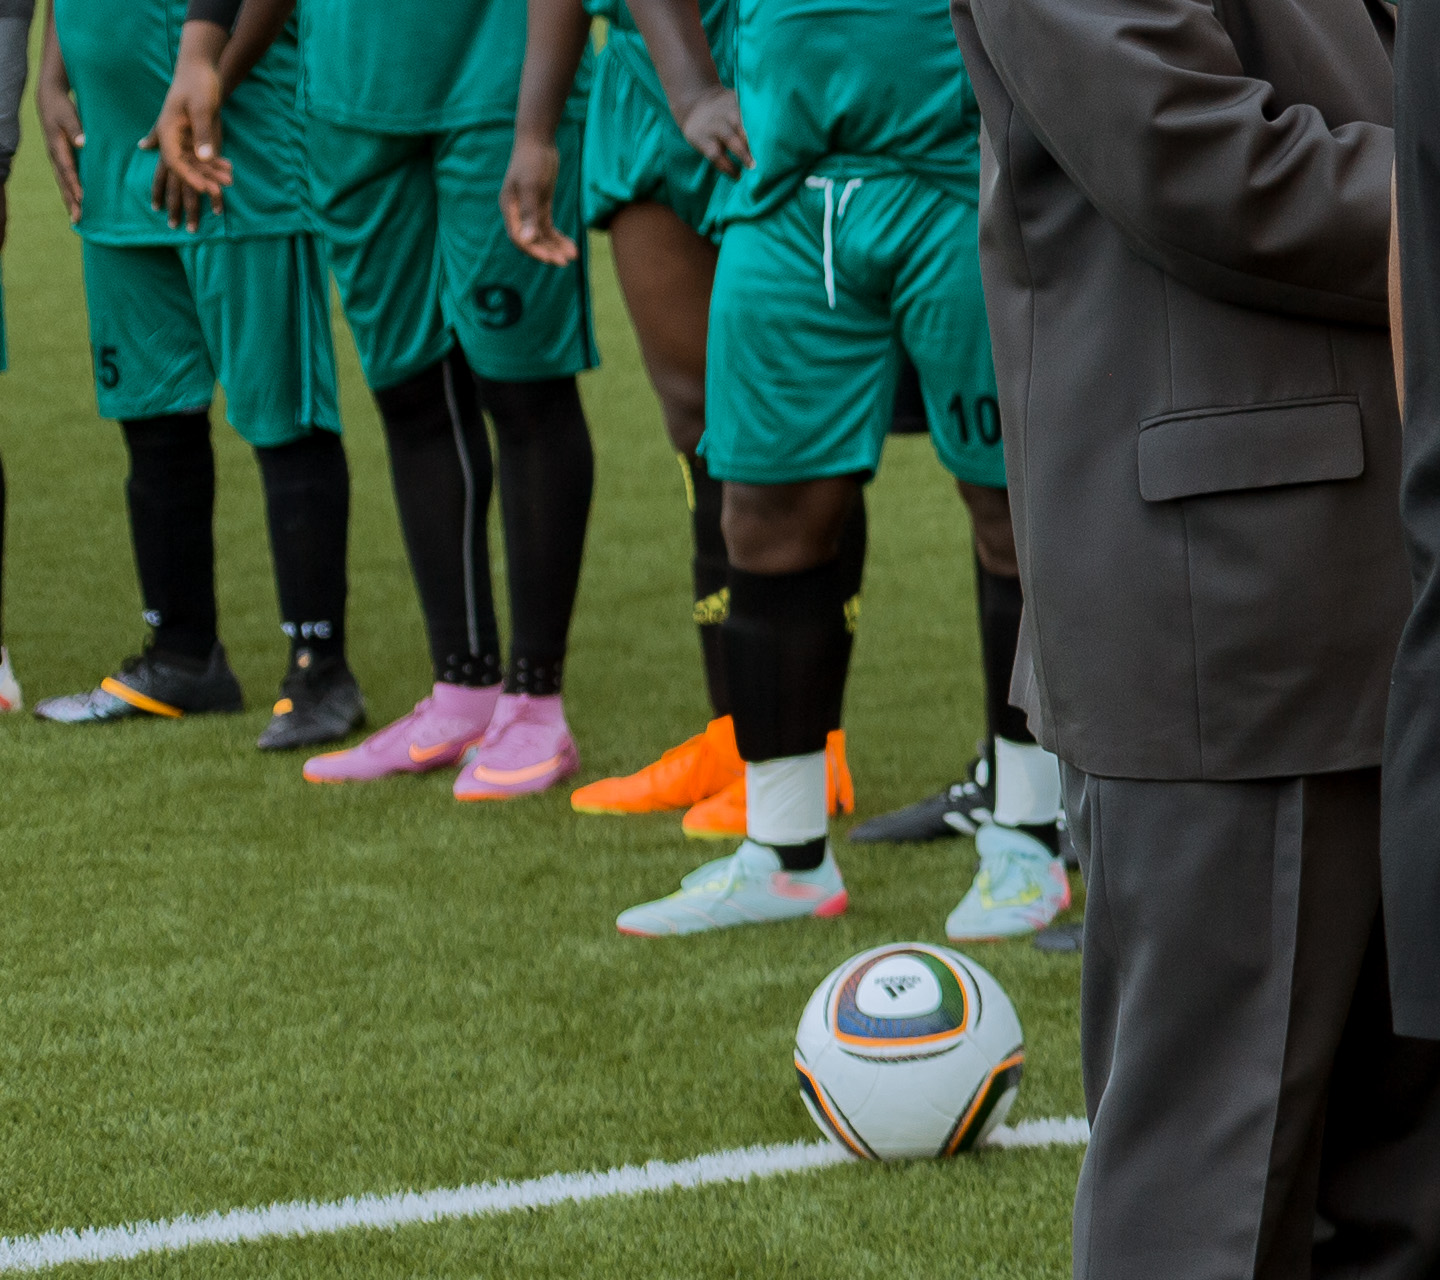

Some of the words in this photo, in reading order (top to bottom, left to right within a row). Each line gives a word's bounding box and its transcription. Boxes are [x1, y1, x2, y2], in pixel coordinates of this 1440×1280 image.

[476, 285, 523, 330] 9
[101, 348, 119, 388] 5
[949, 392, 1002, 446] 10
